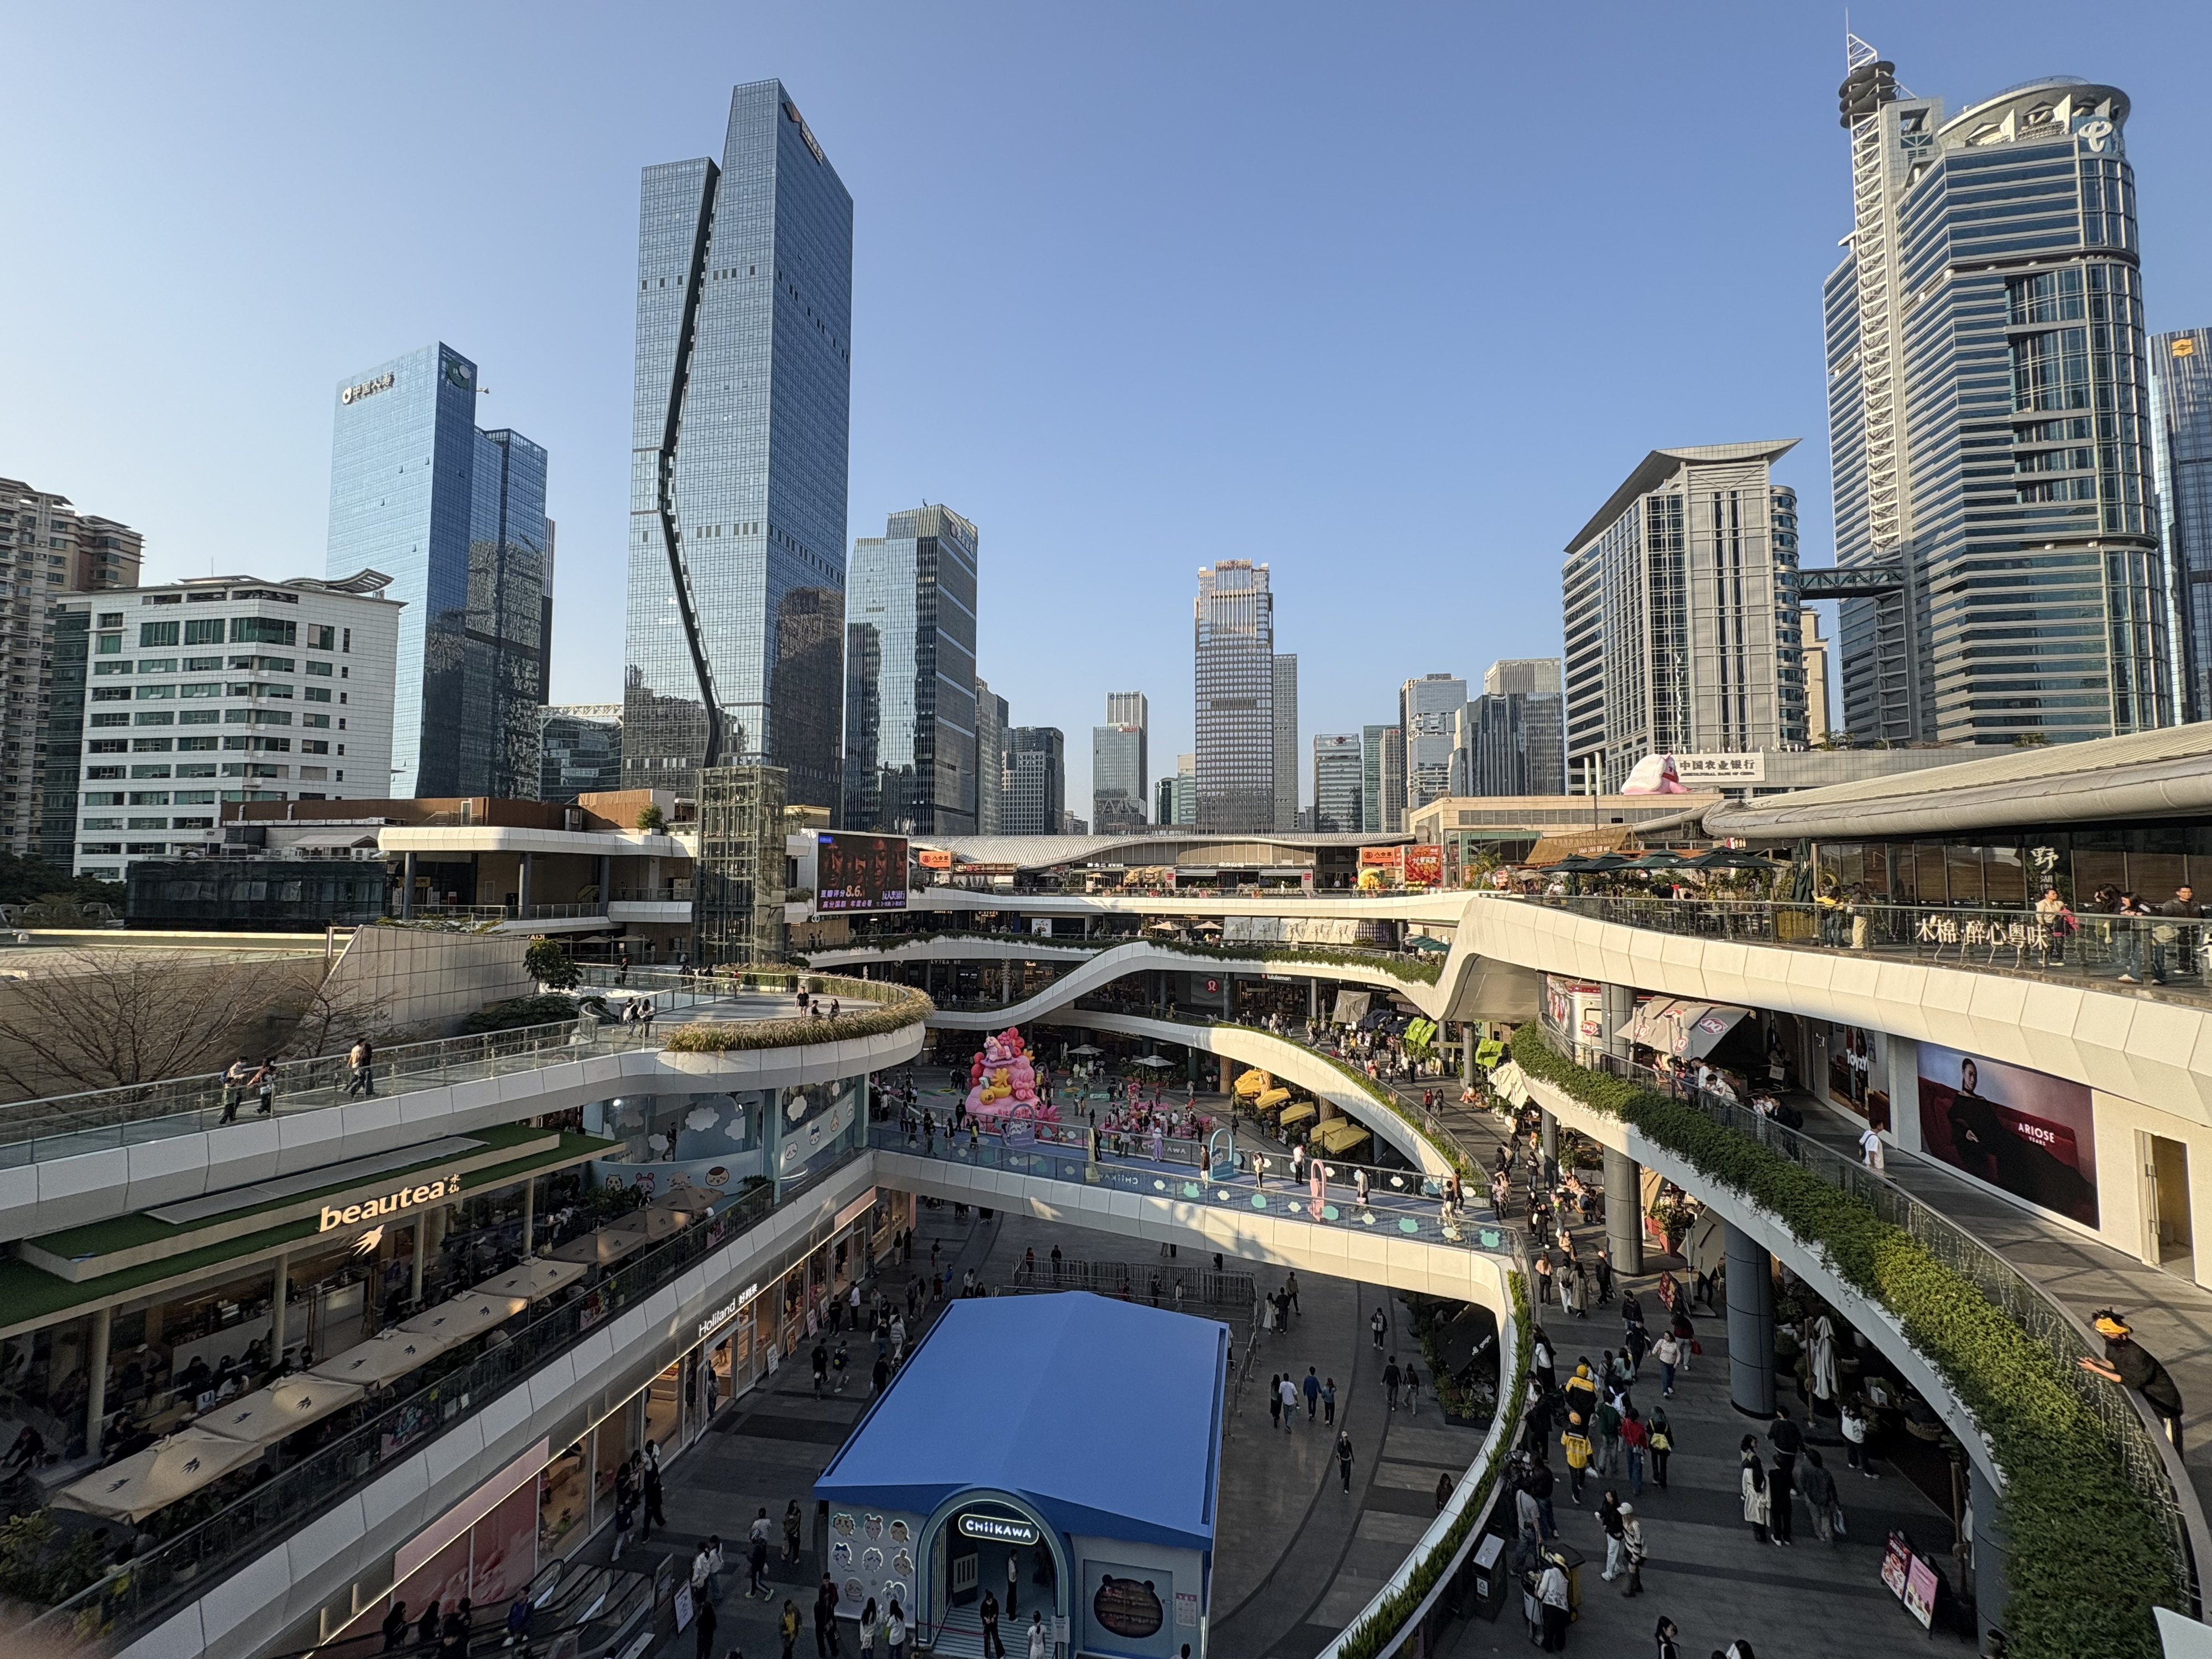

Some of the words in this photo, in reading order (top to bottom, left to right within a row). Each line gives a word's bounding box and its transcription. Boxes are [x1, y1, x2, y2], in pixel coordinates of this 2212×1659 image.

[353, 373, 392, 398] 中国人寿
[1679, 759, 1755, 770] 中国农业银行
[2030, 846, 2059, 874] 野
[1704, 1020, 1724, 1032] DQ
[2018, 1123, 2055, 1143] ARIOSE
[1142, 1142, 1186, 1154] CHAWA
[319, 1181, 445, 1232] beautea
[447, 1173, 461, 1194] 水仙
[698, 1298, 735, 1338] Holiland
[738, 1283, 758, 1306] 好利来
[966, 1520, 1031, 1538] CHiiKAWA
